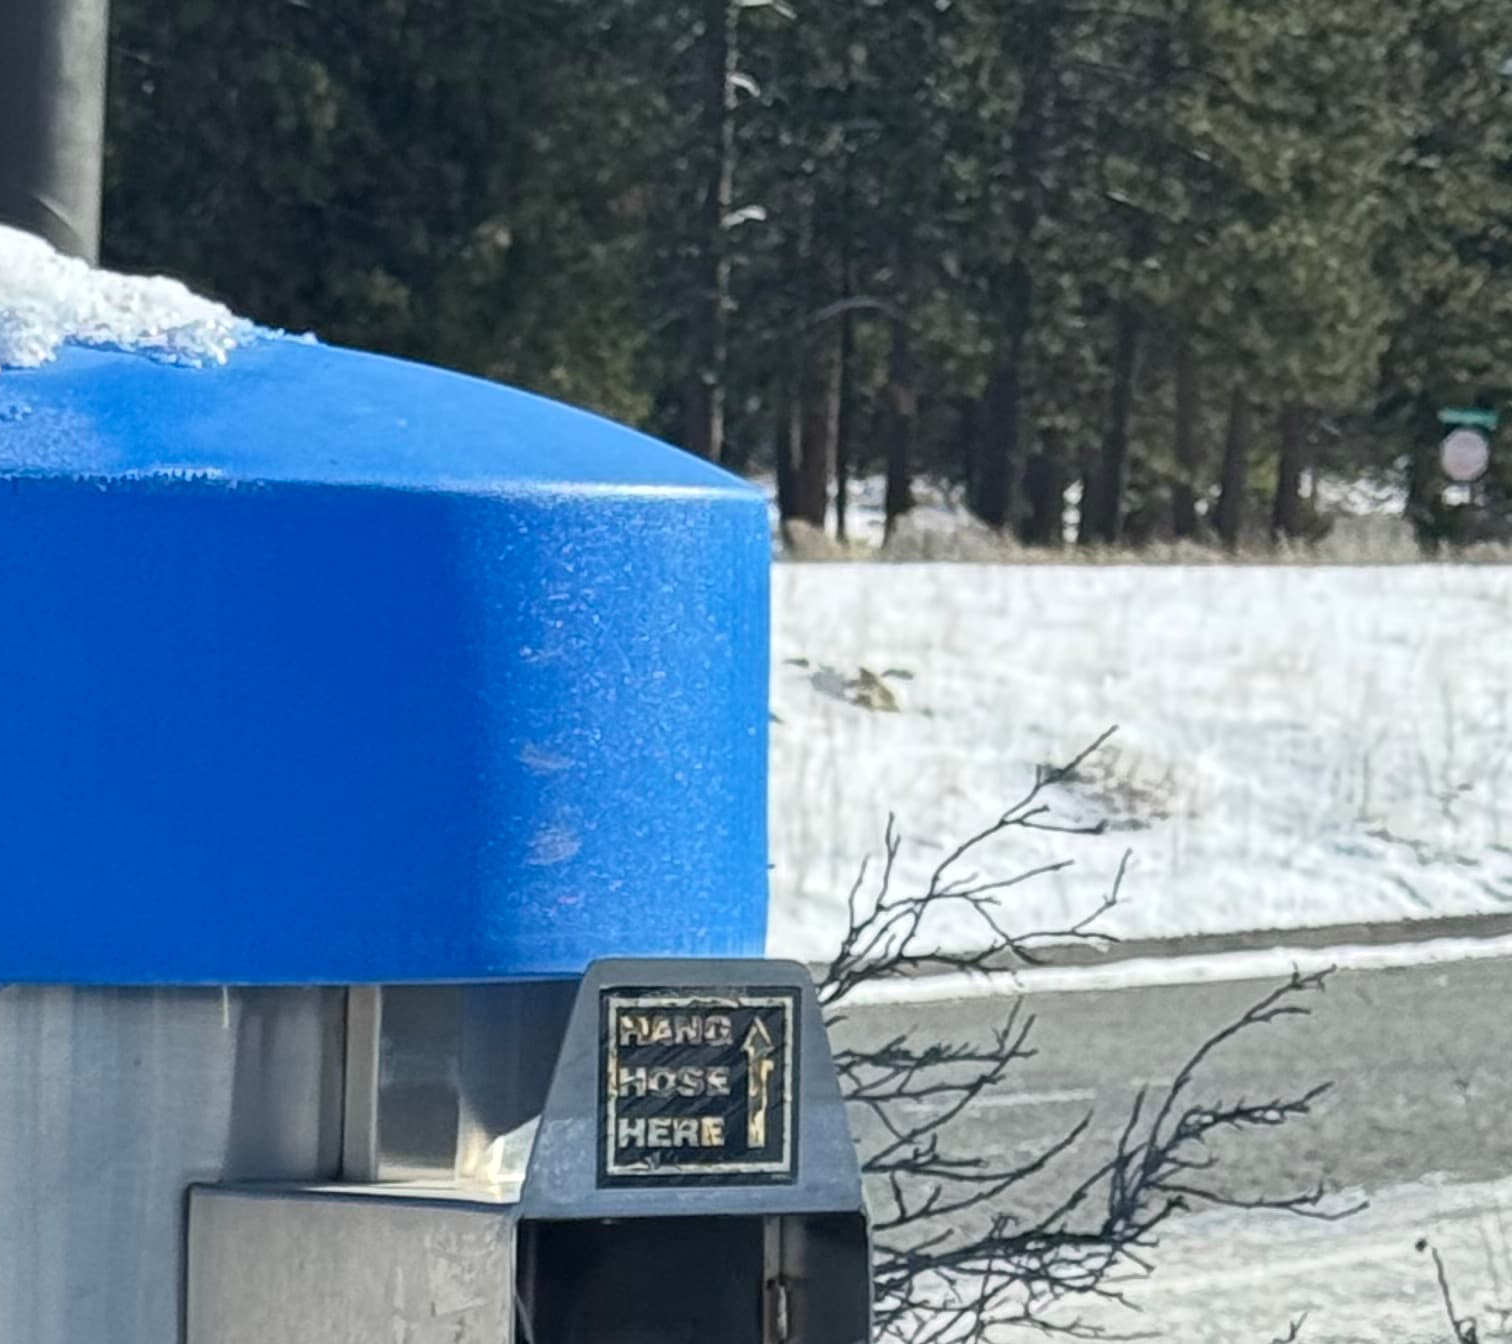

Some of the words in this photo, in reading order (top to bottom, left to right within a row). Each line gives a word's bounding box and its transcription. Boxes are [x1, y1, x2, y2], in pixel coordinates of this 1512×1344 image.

[618, 1014, 734, 1046] HANG
[618, 1065, 732, 1098] HOSE
[617, 1116, 726, 1148] HERE
